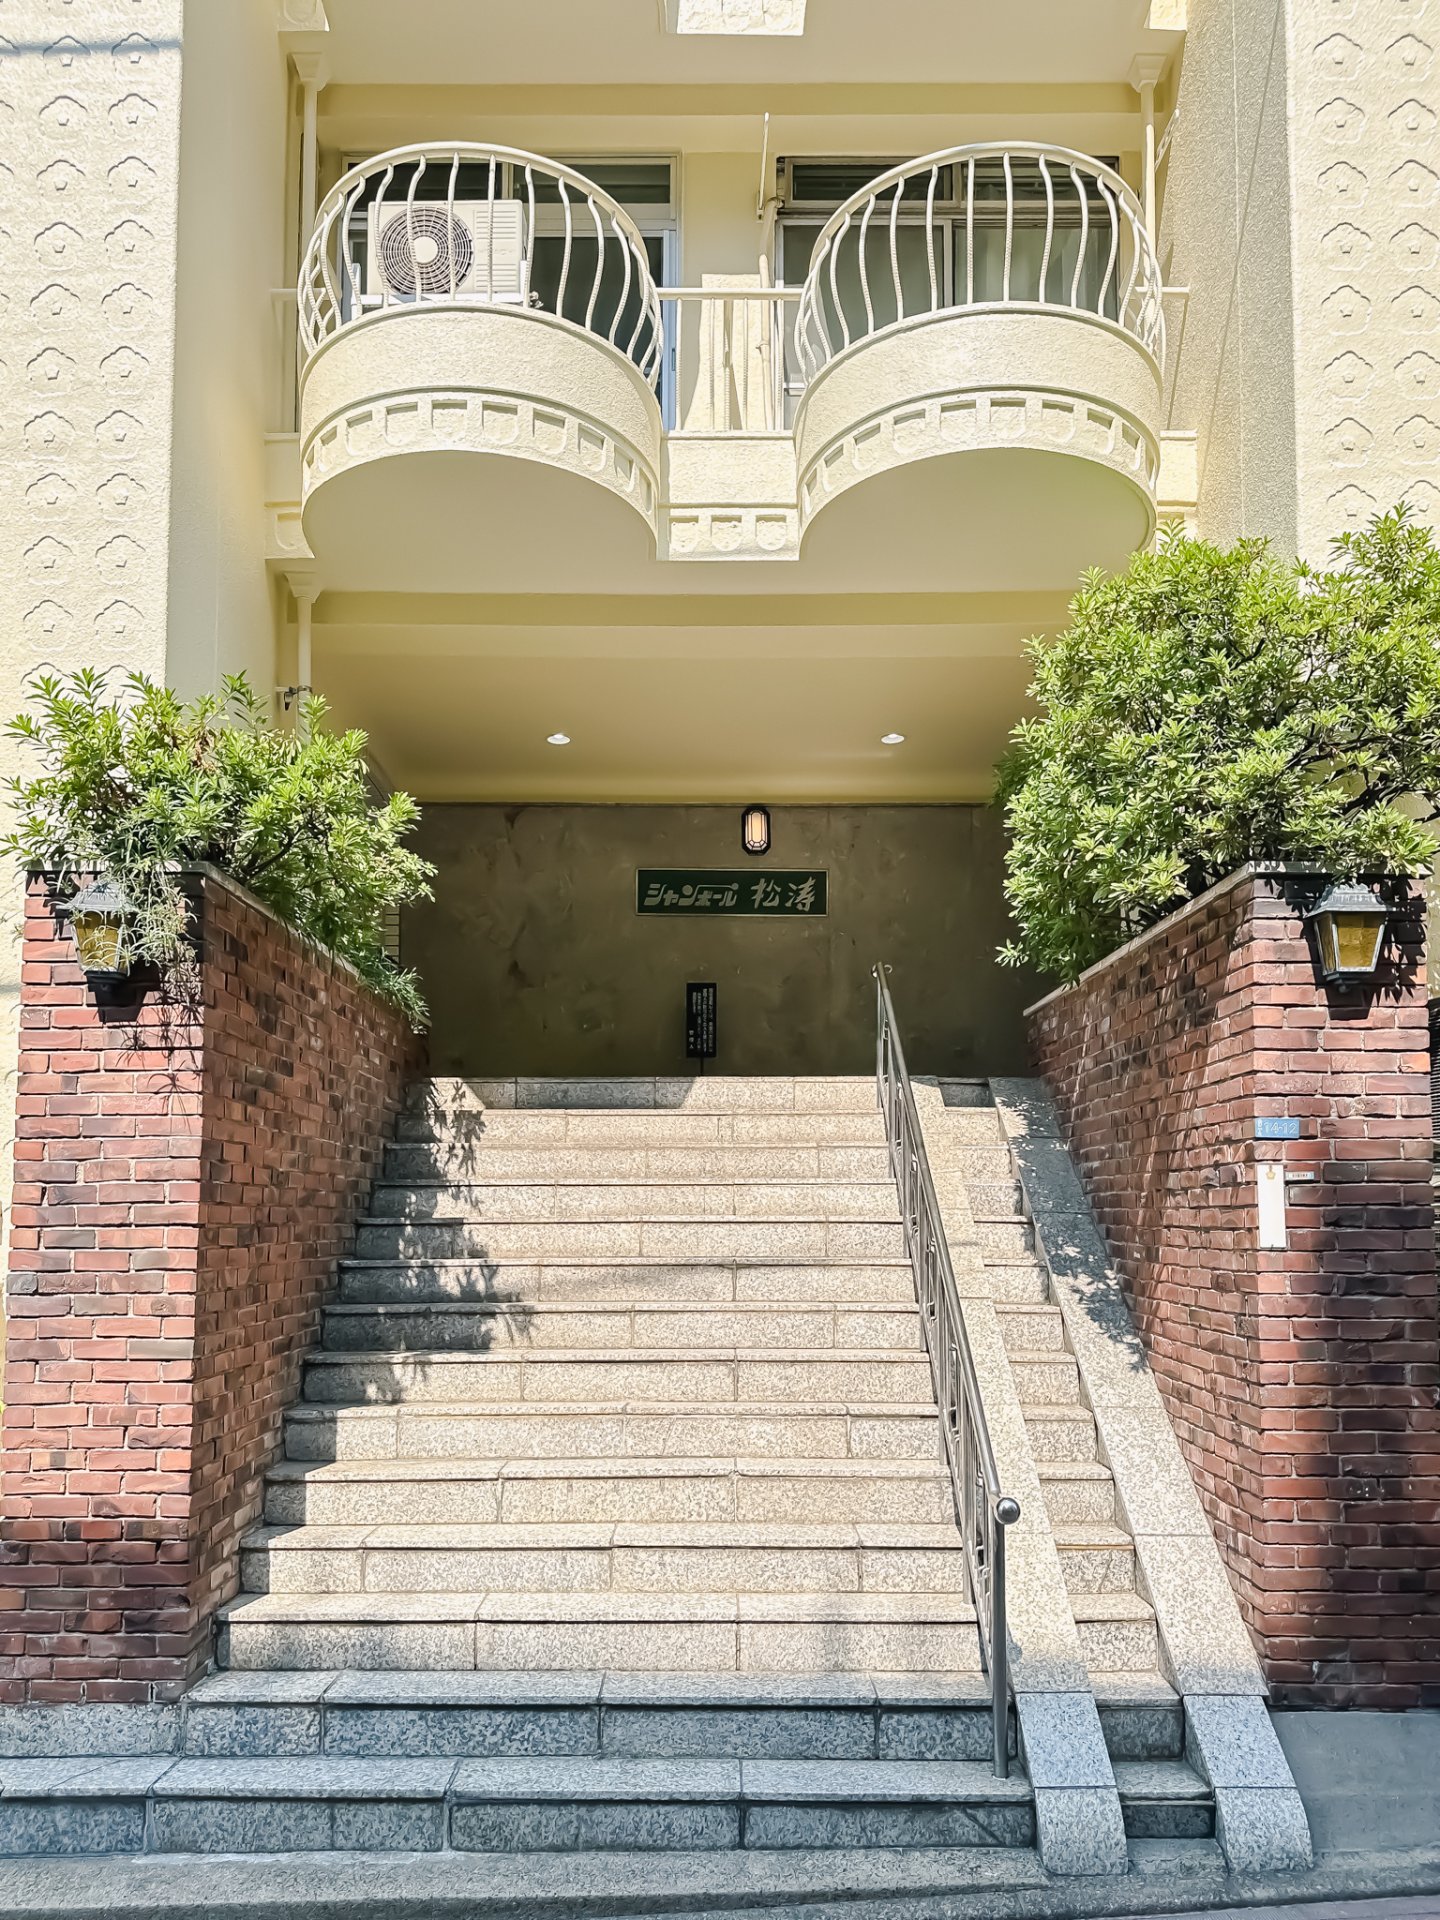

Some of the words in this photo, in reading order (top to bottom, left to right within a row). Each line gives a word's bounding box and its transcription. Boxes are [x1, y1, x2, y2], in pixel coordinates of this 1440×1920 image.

[643, 882, 739, 906] シャンボール
[1263, 1121, 1297, 1134] 14-12
